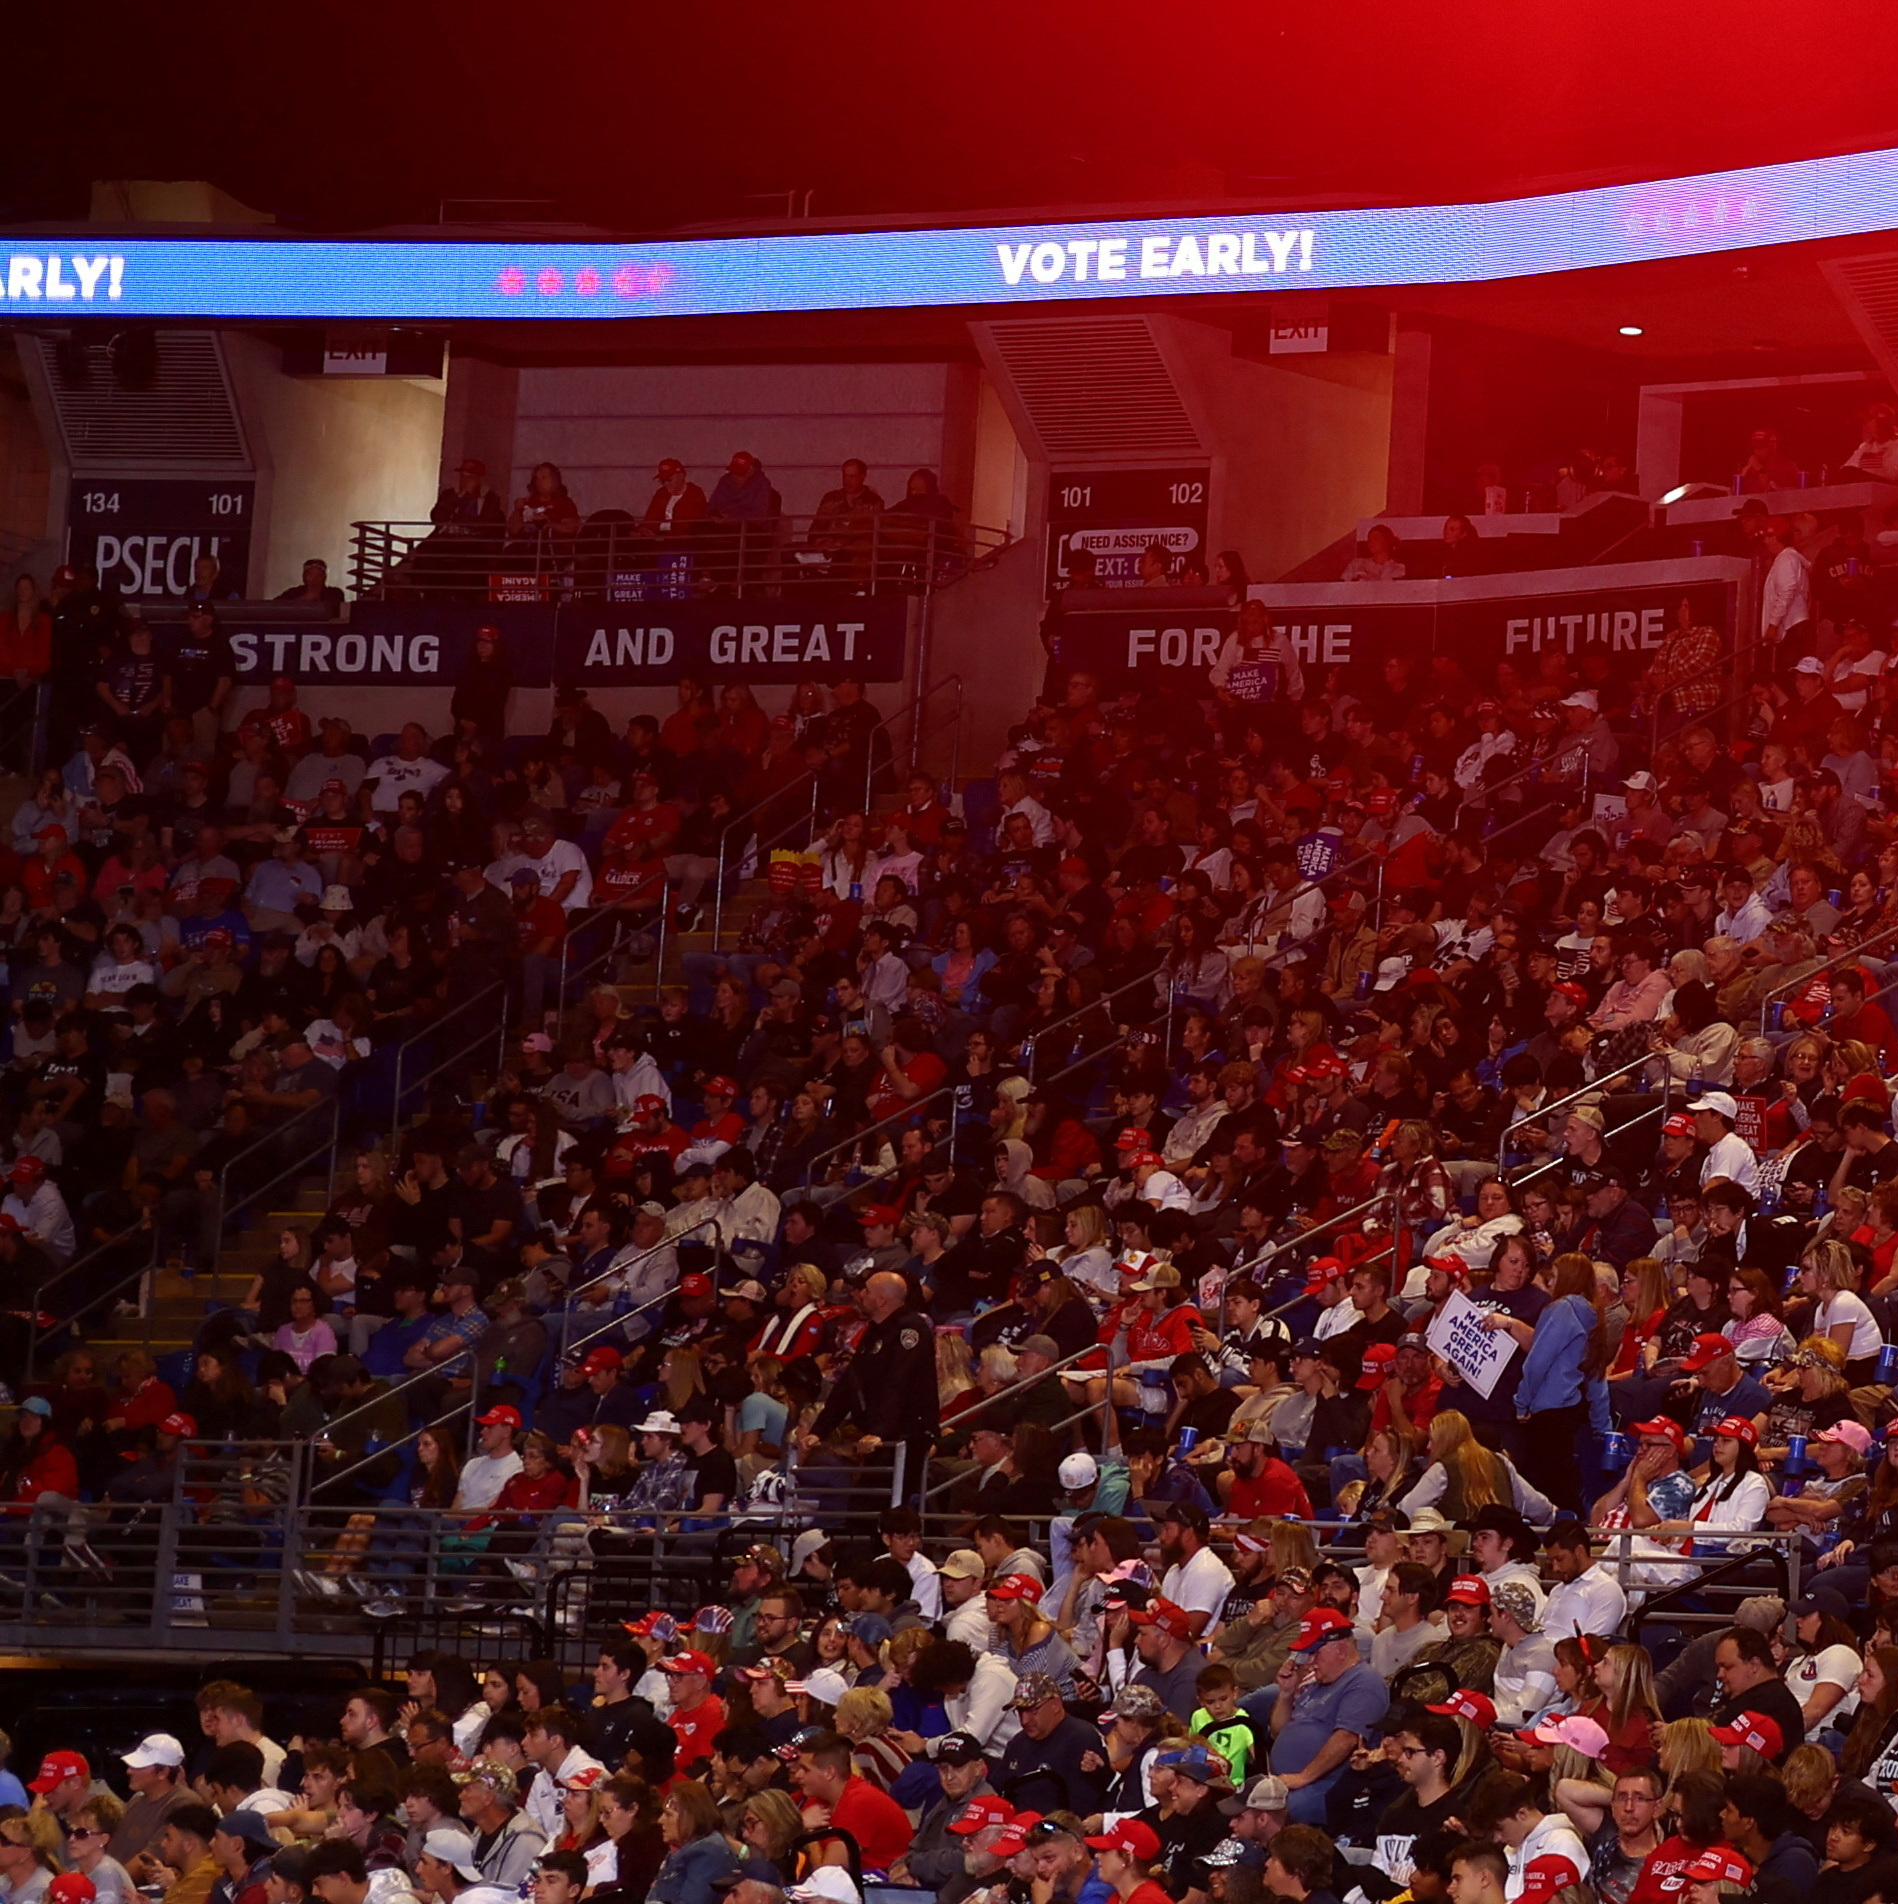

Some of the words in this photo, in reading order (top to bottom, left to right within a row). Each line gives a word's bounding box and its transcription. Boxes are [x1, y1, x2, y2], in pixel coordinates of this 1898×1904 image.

[997, 239, 1127, 284] VOTE
[1139, 230, 1316, 279] EARLY!
[0, 256, 126, 302] RLY!
[1273, 318, 1322, 340] EXIT
[83, 492, 120, 515] 134
[208, 493, 244, 515] 101
[1060, 486, 1092, 508] 101
[1168, 483, 1204, 506] 102
[1081, 534, 1111, 550] NEED
[1113, 532, 1189, 548] ASSISTANCE?
[230, 632, 441, 674] STRONG
[585, 628, 675, 668] AND
[710, 623, 873, 665] GREAT.
[1126, 628, 1218, 668] FOR
[1449, 1316, 1503, 1364] AMERICA
[1464, 1310, 1497, 1344] MAKE
[1443, 1343, 1483, 1380] AGAIN!
[1450, 1331, 1489, 1367] GREAT
